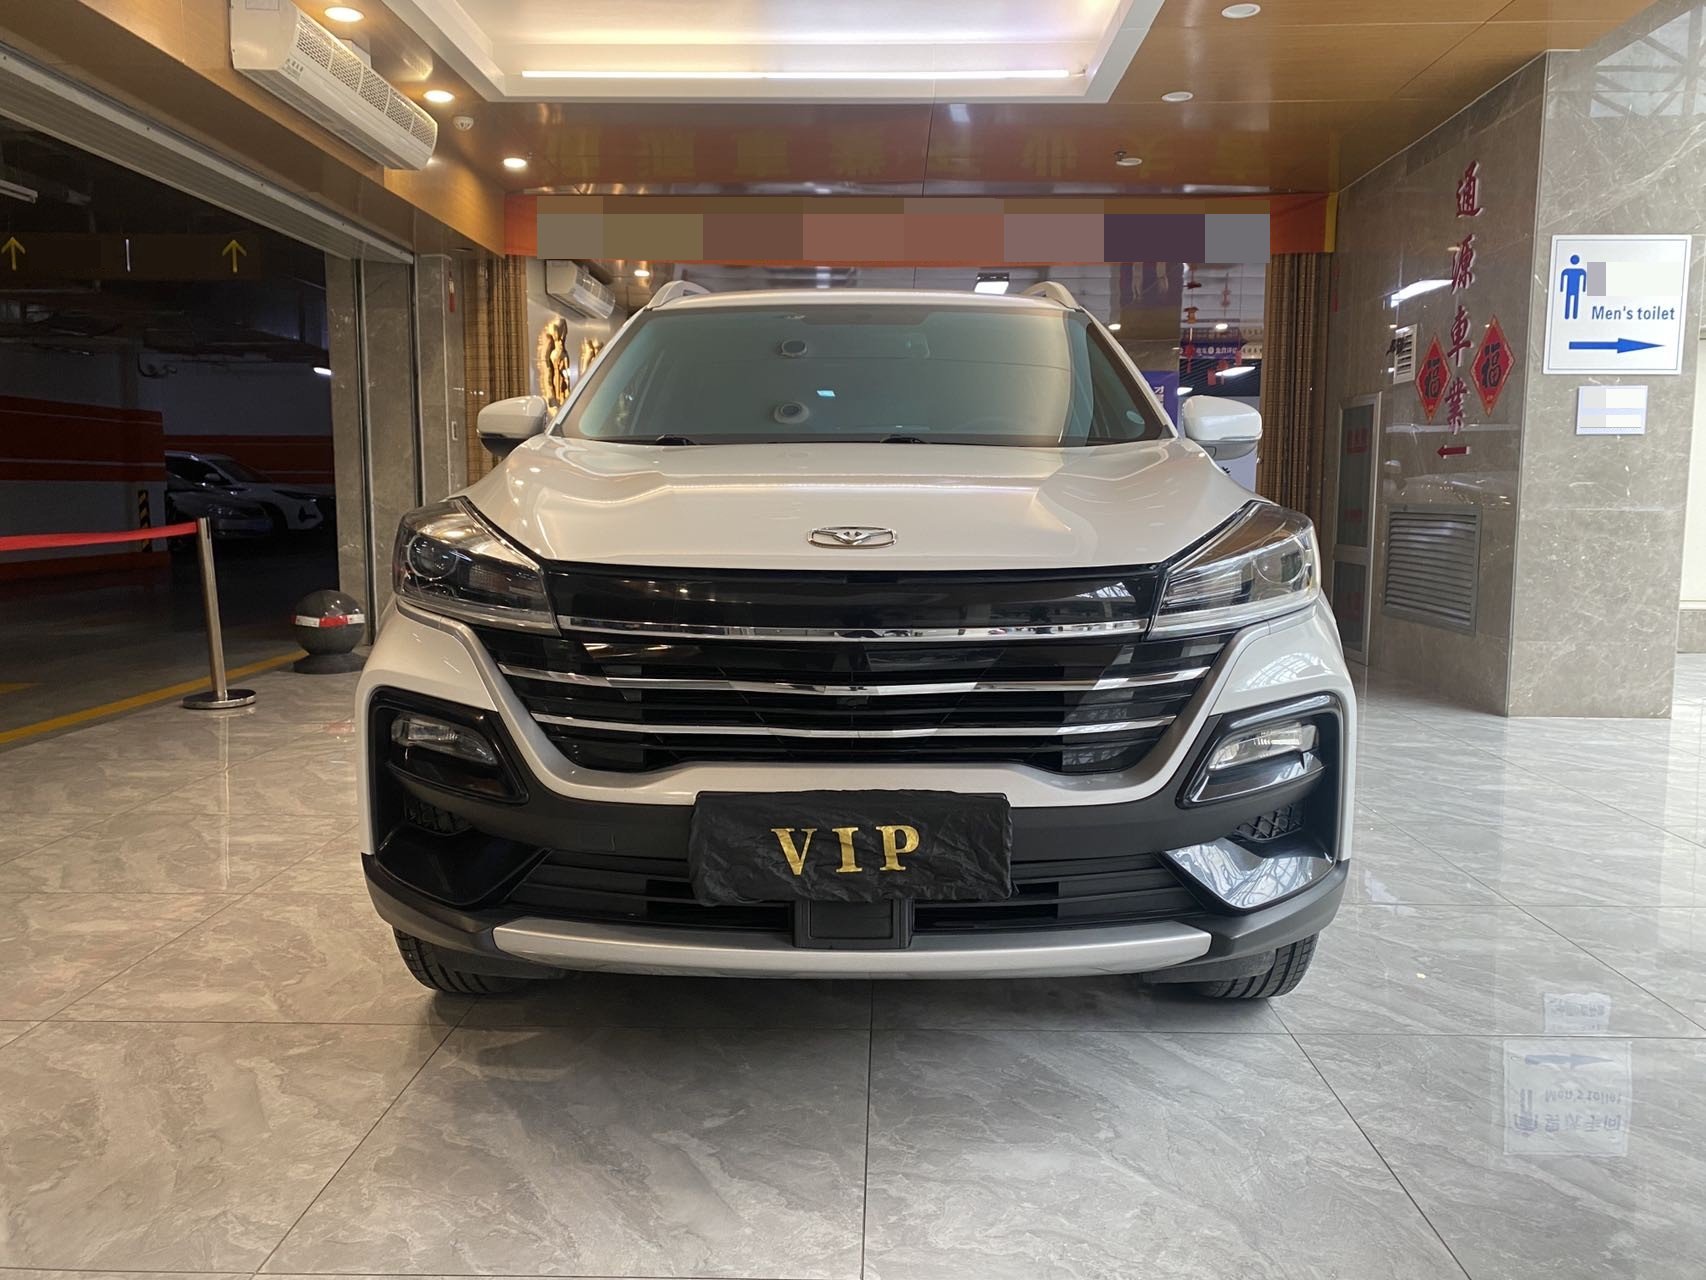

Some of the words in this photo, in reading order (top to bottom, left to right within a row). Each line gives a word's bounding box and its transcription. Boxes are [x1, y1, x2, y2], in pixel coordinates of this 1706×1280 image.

[1591, 305, 1633, 320] Men's
[1637, 305, 1675, 320] toilet
[770, 824, 920, 875] VIP
